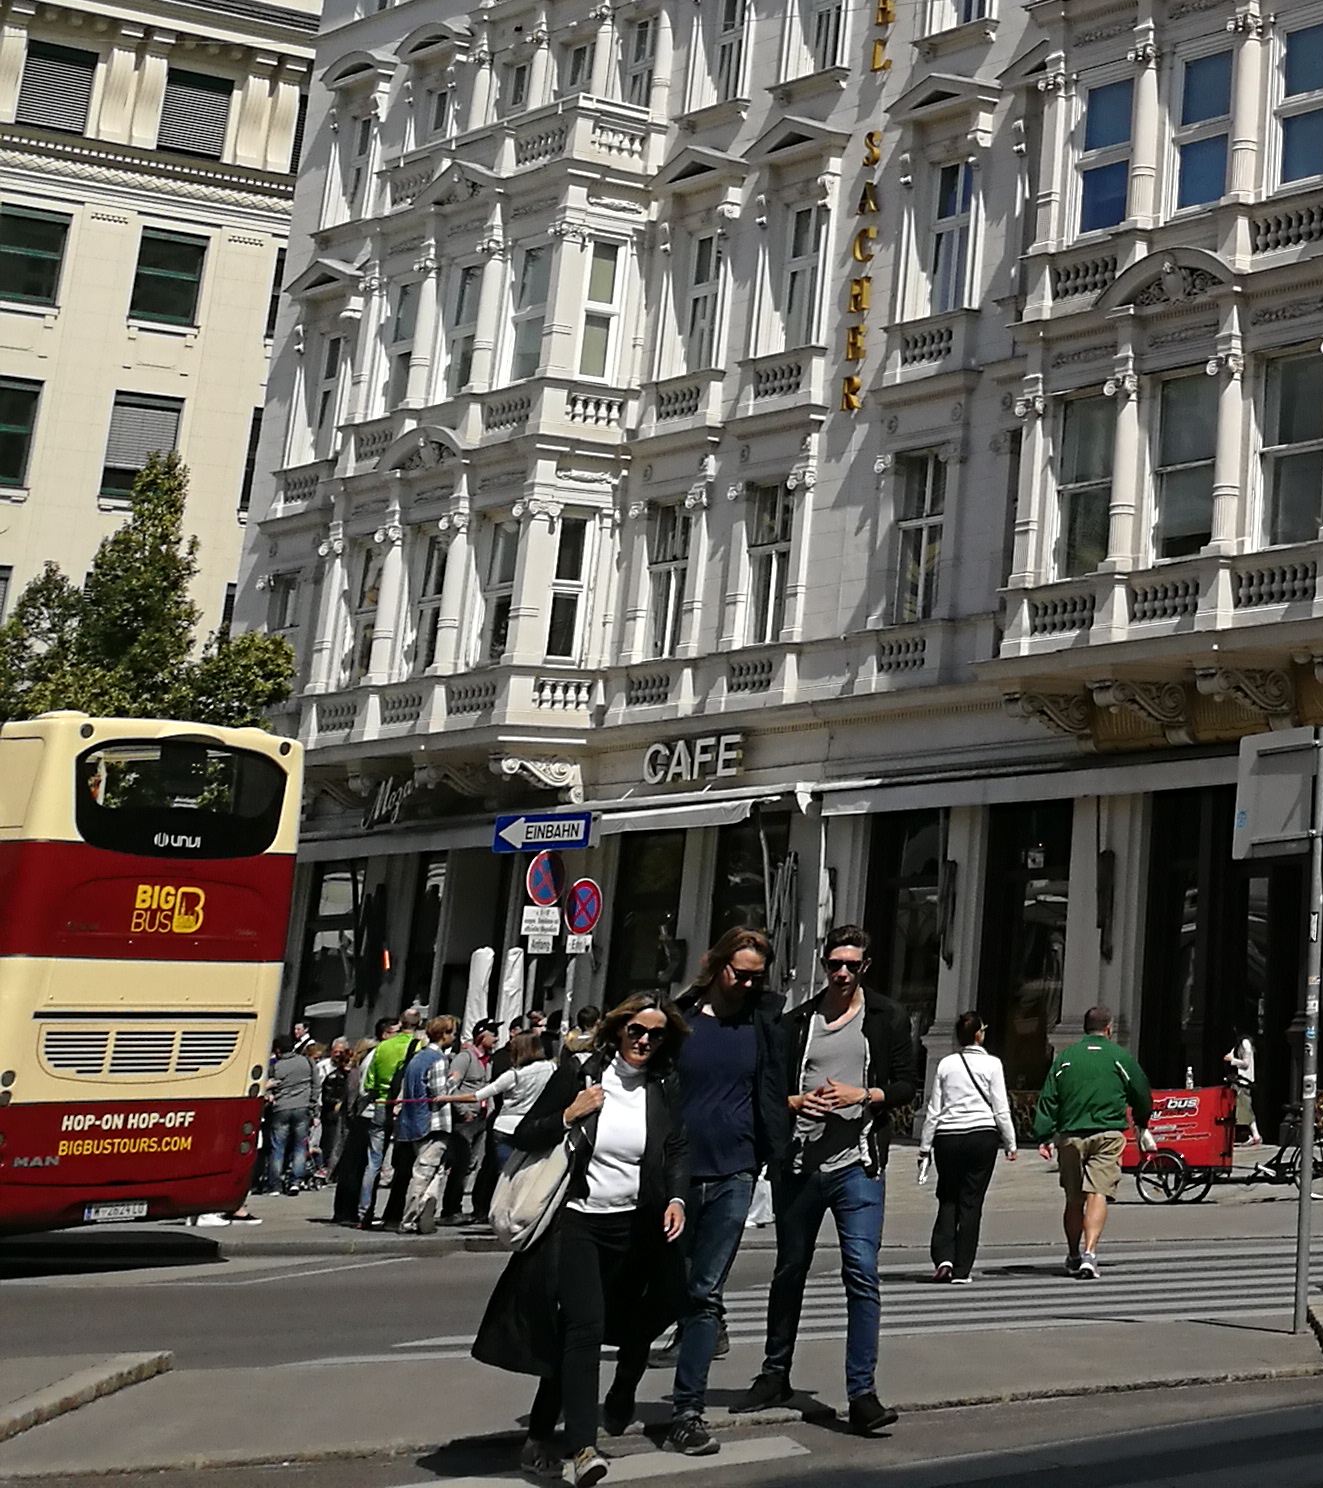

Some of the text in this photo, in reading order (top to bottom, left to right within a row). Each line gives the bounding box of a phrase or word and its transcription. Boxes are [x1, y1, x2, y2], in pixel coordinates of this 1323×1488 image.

[840, 130, 883, 411] SACHER
[643, 733, 742, 785] CAFE
[524, 822, 581, 842] EINBAHN
[135, 884, 176, 910] BIG
[130, 910, 171, 934] BUS
[61, 1111, 196, 1132] HOP-ON HOP-OFF
[58, 1136, 193, 1157] BIGBUSTOURS.COM
